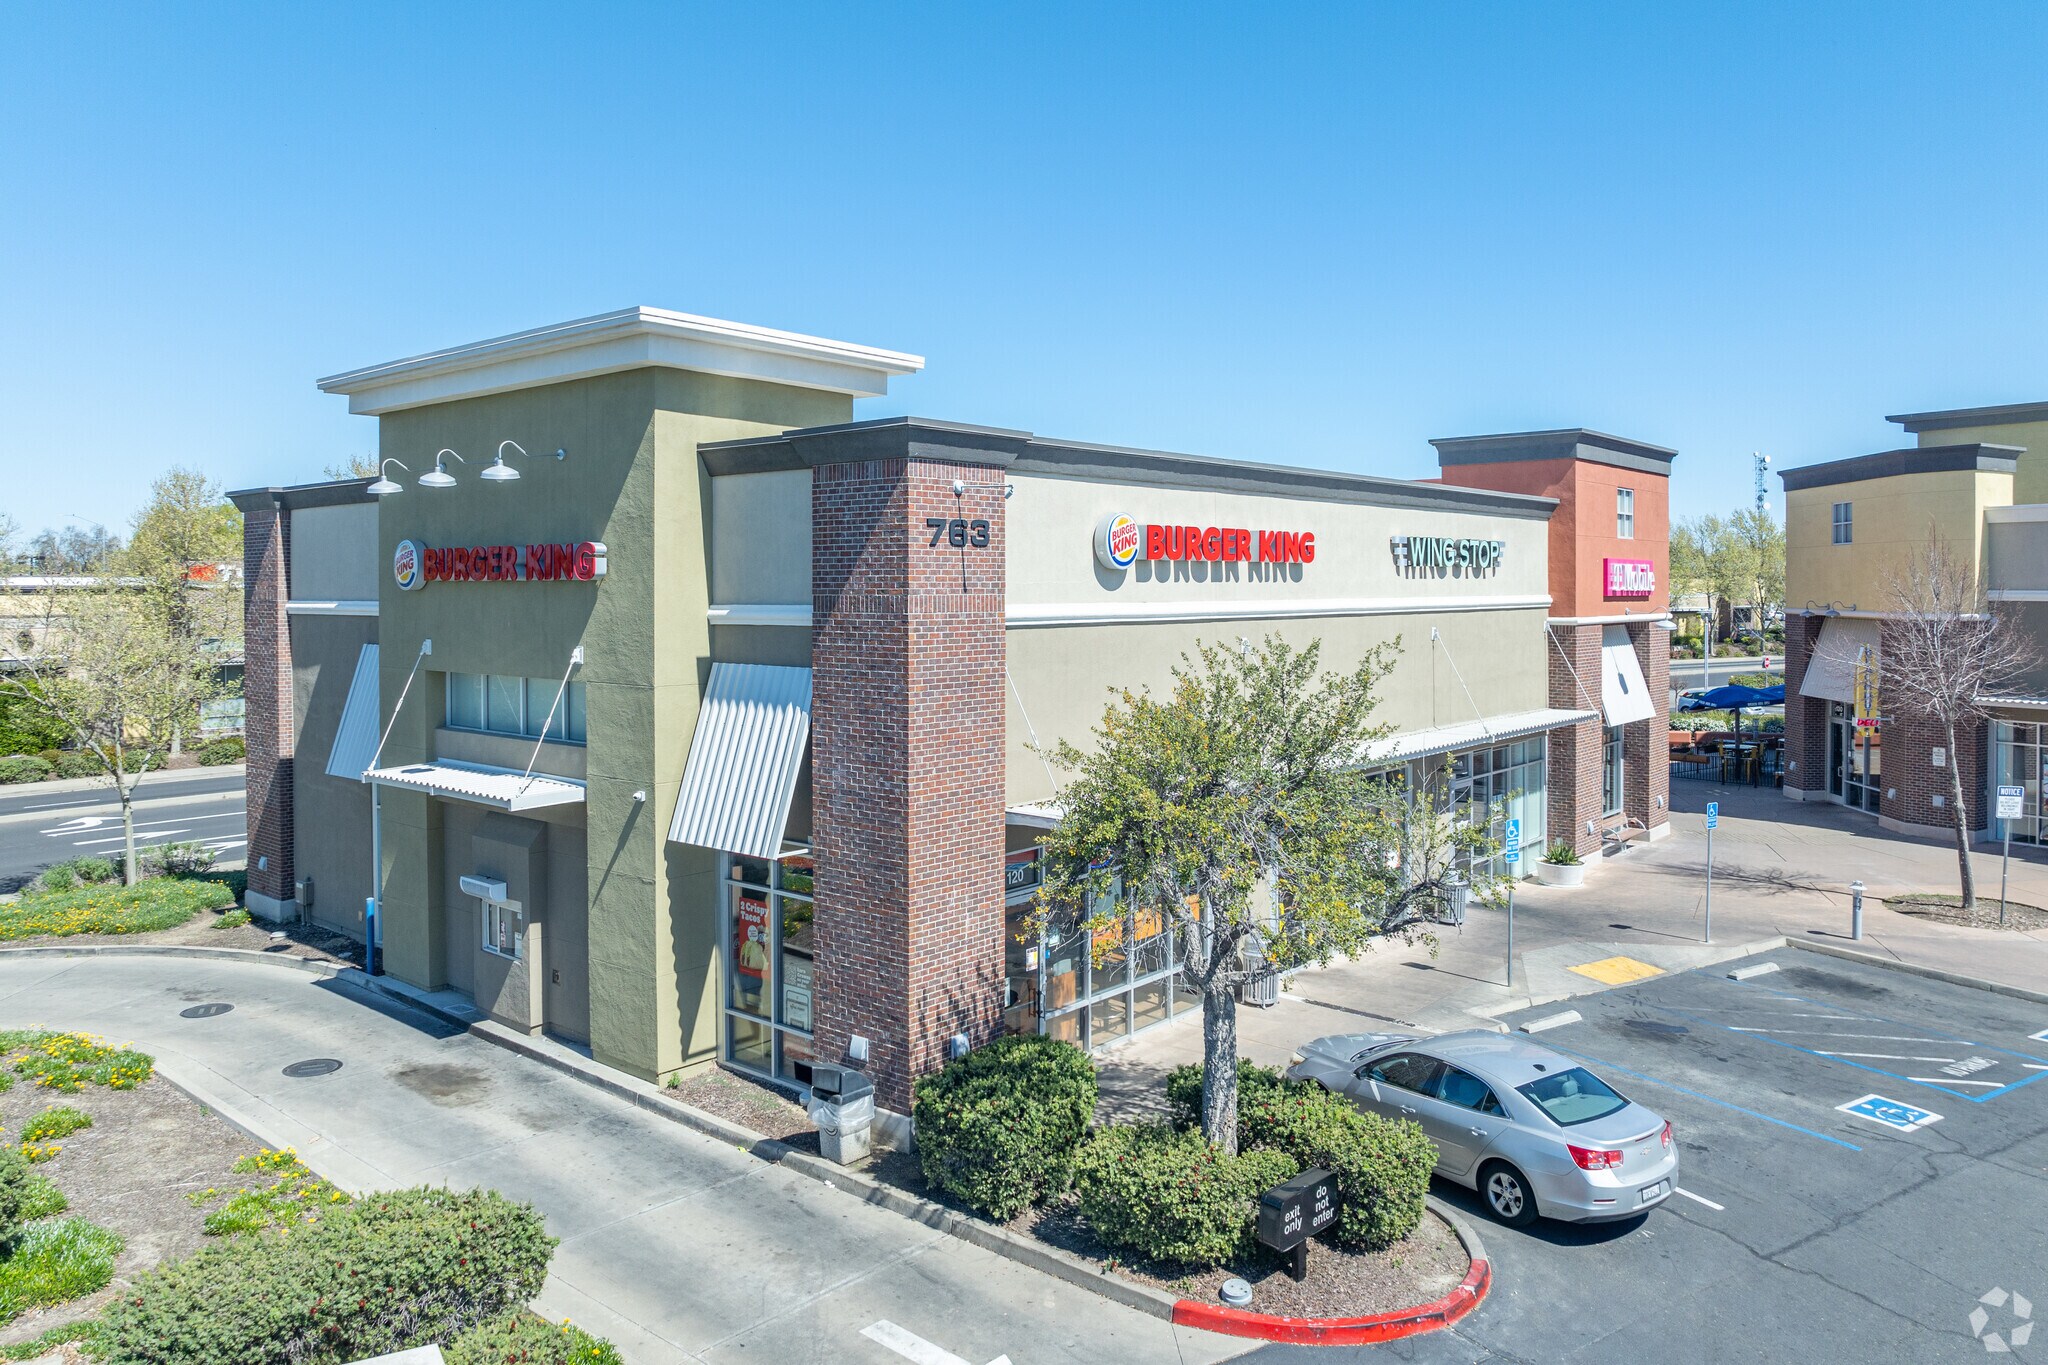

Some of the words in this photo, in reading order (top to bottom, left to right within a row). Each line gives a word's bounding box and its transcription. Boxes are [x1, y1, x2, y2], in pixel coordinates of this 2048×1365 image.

[927, 518, 990, 548] 763
[1112, 523, 1137, 541] BURGER
[1112, 532, 1137, 555] KING
[1147, 525, 1251, 561] BURGER
[1259, 530, 1315, 564] KING
[396, 550, 414, 566] BURGER
[424, 545, 518, 582] BURGER
[526, 542, 597, 581] KING
[396, 558, 414, 577] KING
[1857, 718, 1880, 727] DELI
[2000, 788, 2021, 796] NOTICE
[1007, 869, 1024, 884] 120
[740, 901, 746, 910] 2
[746, 902, 769, 917] Crispy
[741, 911, 760, 923] Tacos
[1316, 1185, 1327, 1199] do
[1315, 1195, 1329, 1212] not
[1285, 1204, 1300, 1222] exit
[1312, 1207, 1335, 1227] enter
[1284, 1217, 1302, 1235] only
